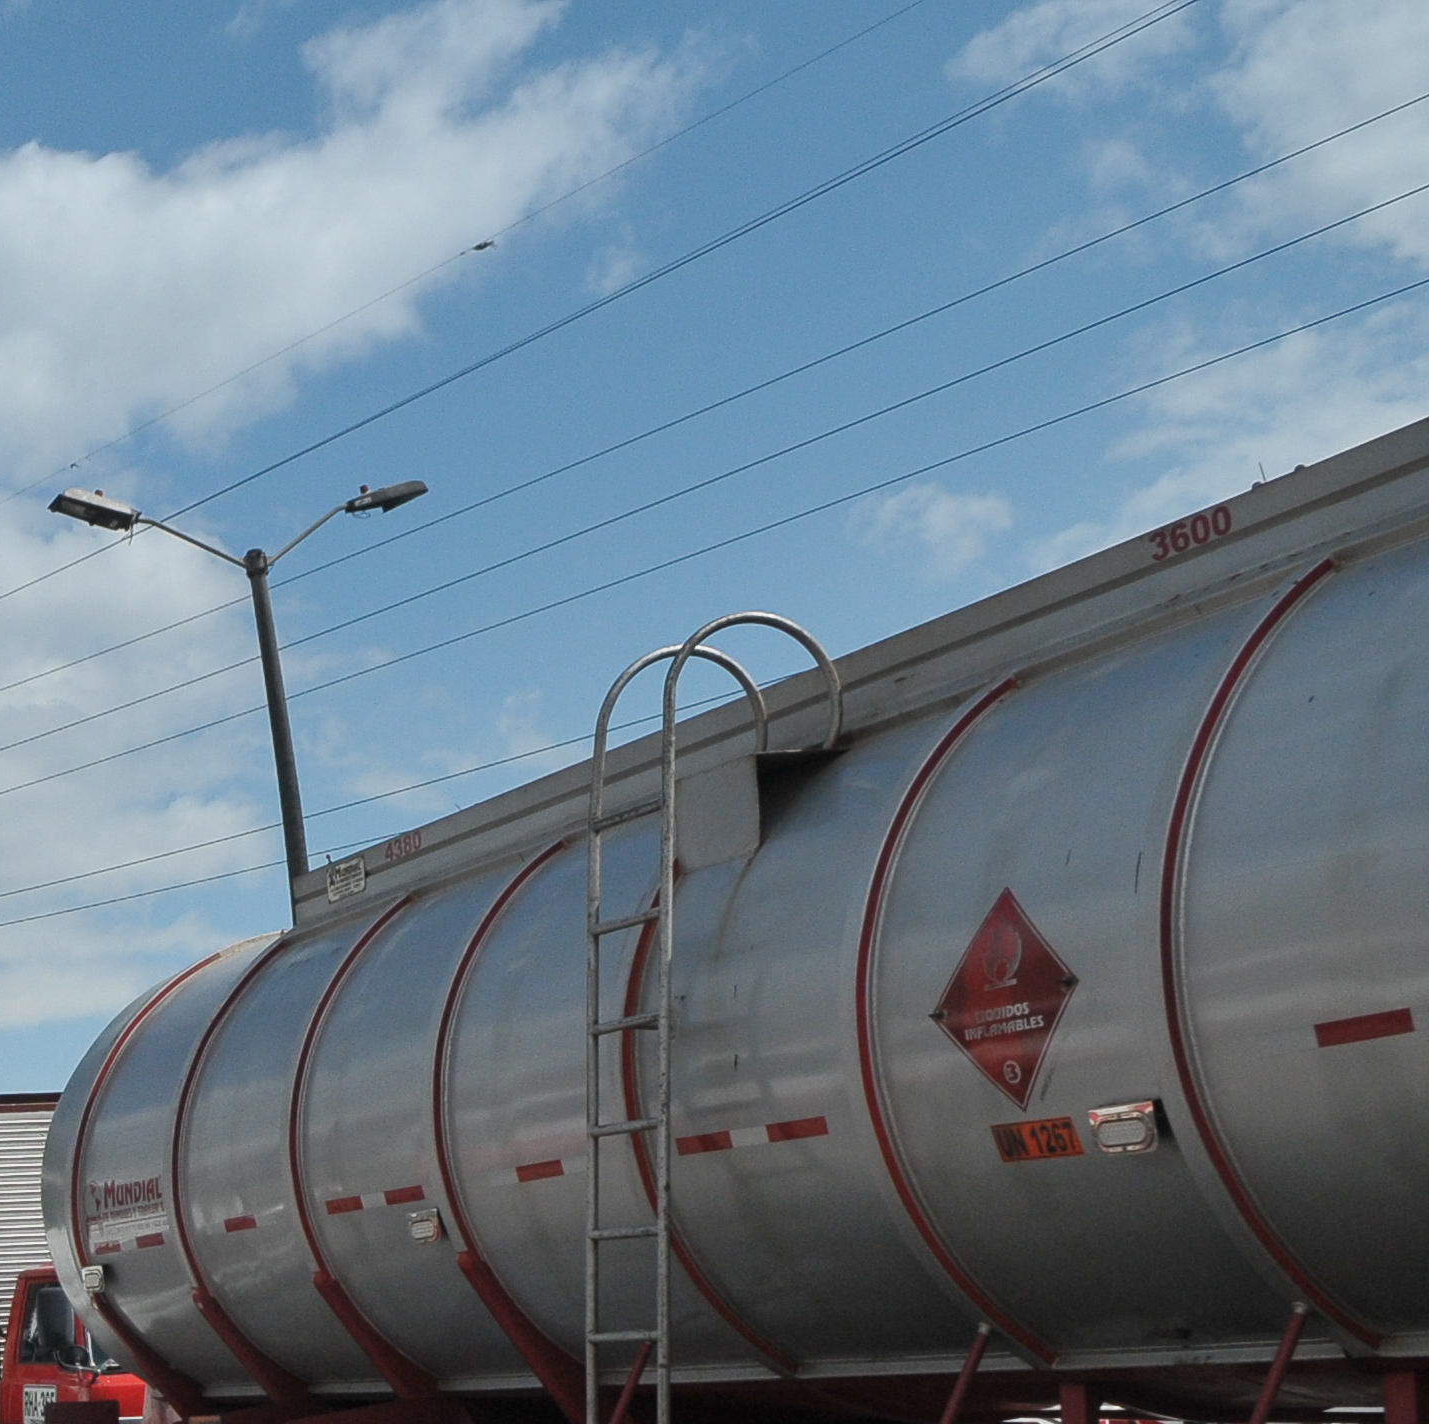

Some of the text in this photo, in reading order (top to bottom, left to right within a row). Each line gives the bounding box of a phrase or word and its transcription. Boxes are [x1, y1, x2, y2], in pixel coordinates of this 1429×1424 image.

[1148, 506, 1232, 561] 3600
[385, 831, 422, 861] 4380
[964, 1016, 1045, 1041] INFLAMABLES
[1007, 1064, 1019, 1081] 3
[996, 1121, 1076, 1158] UN 1267
[104, 1177, 163, 1209] MUNDIAL
